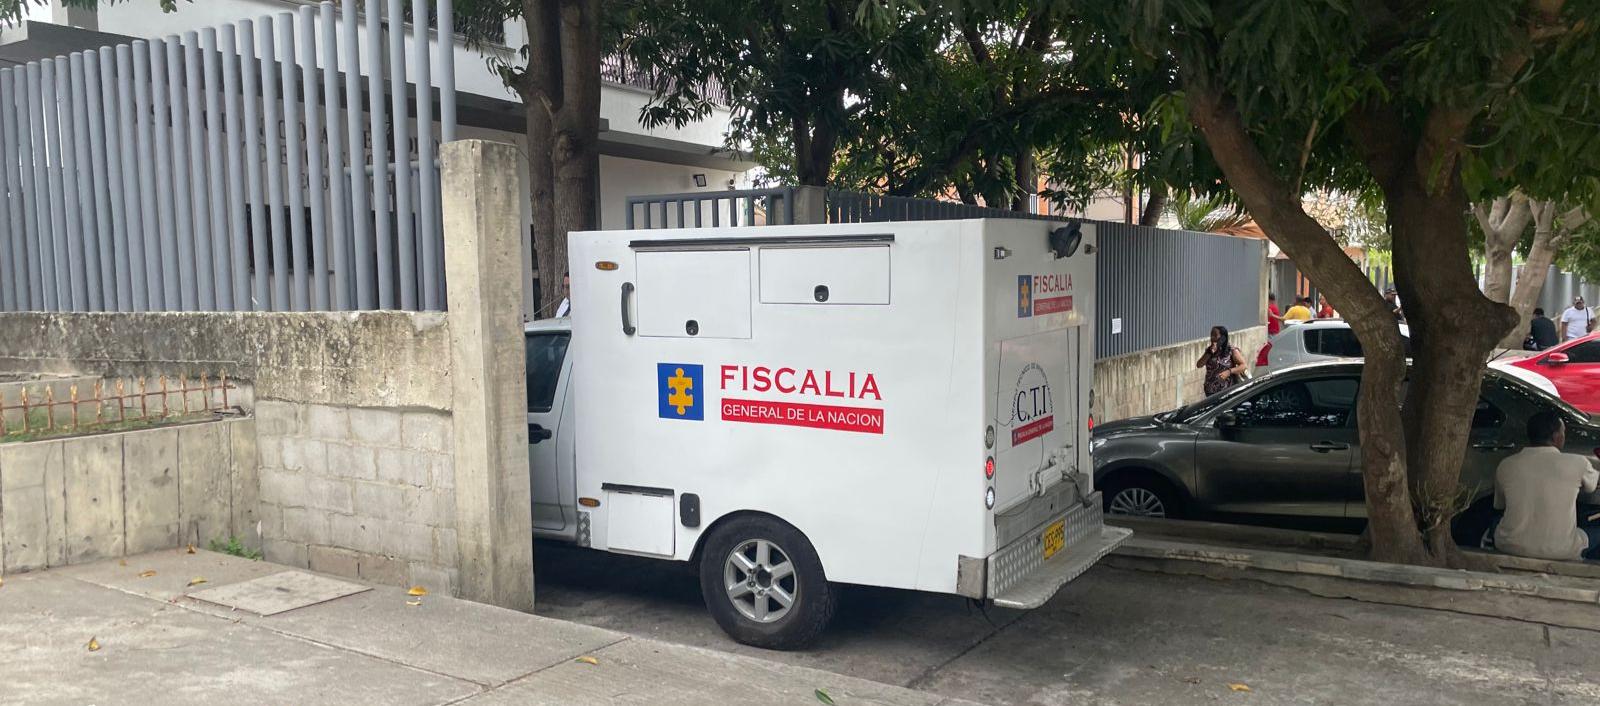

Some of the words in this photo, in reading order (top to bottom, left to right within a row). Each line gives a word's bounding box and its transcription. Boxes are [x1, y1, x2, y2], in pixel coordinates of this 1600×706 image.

[1033, 273, 1072, 293] FISCALIA
[720, 365, 882, 400] FISCALIA
[723, 404, 783, 419] GENERAL
[787, 407, 805, 421] DE
[808, 410, 825, 423] LA
[827, 411, 881, 427] NACION
